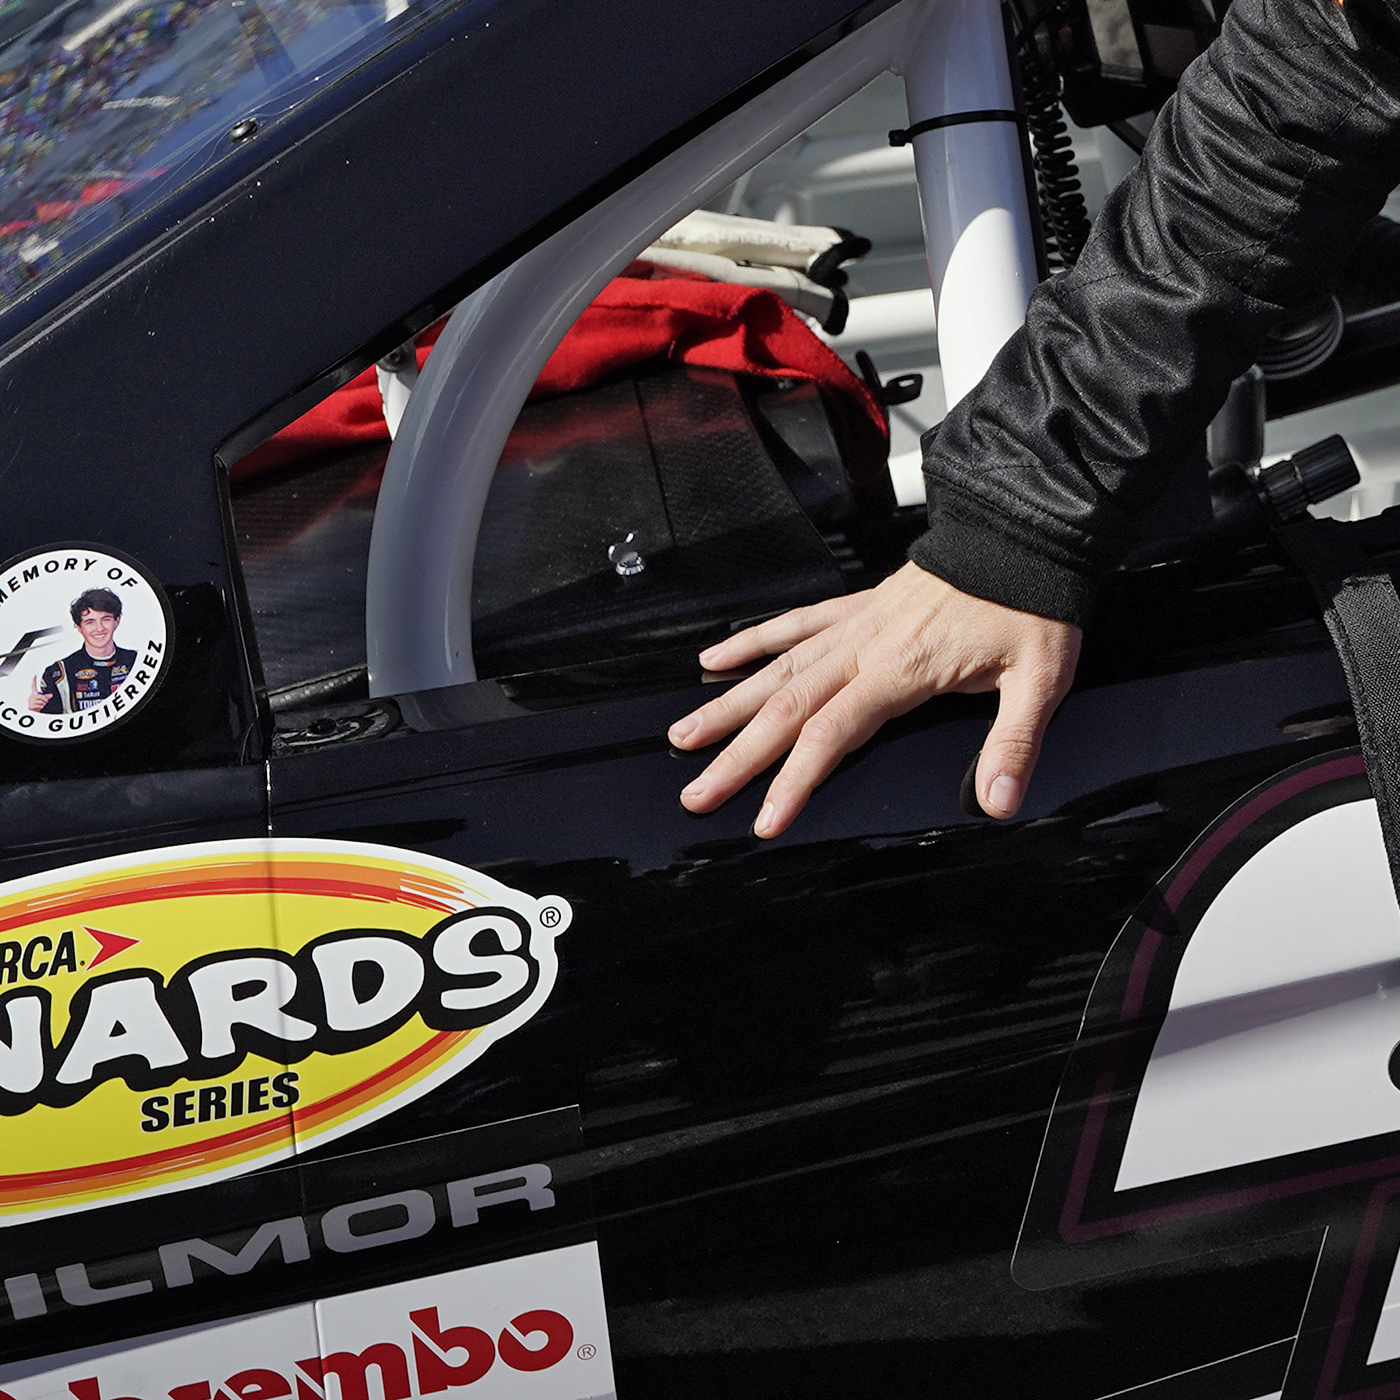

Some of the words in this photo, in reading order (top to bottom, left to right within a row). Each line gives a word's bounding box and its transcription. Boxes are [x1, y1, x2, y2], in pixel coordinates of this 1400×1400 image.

[107, 567, 138, 590] OF
[48, 639, 162, 732] GUTIÉRREZ
[140, 1072, 300, 1133] SERIES
[4, 1163, 555, 1320] ILMOR
